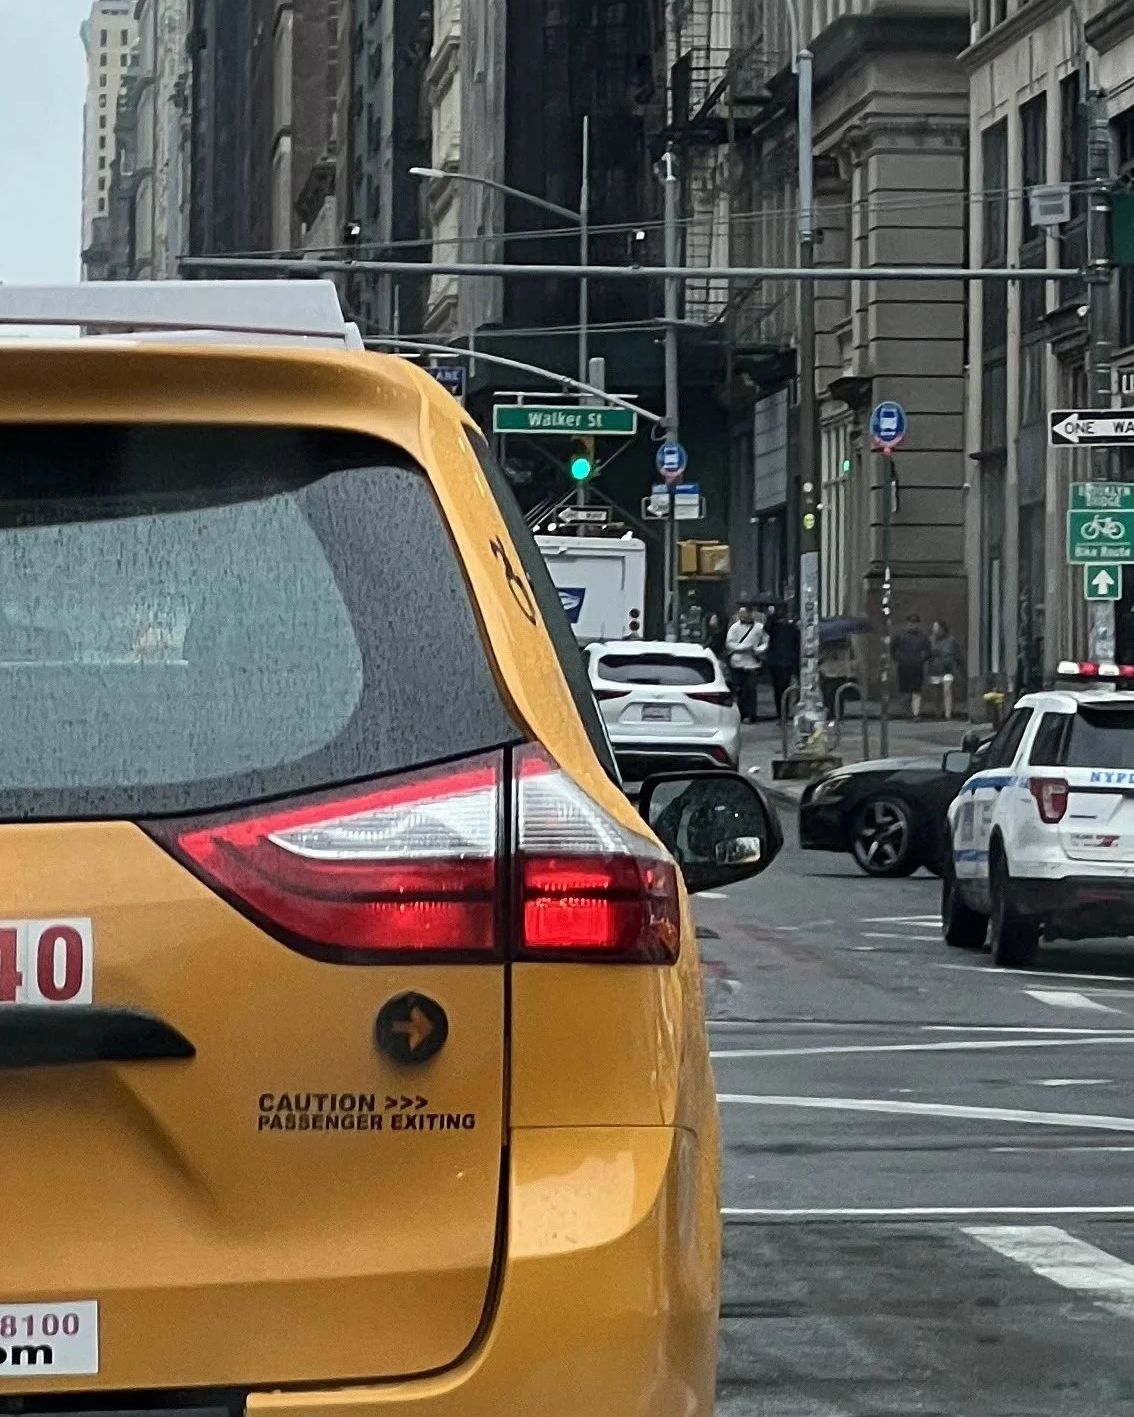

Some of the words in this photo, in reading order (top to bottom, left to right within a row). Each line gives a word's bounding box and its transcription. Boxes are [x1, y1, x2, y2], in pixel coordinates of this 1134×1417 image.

[528, 411, 581, 428] Walker
[587, 411, 602, 428] St
[1064, 422, 1096, 435] ONE
[258, 1093, 375, 1113] CAUTION
[257, 1113, 383, 1131] PASSENGER
[391, 1114, 476, 1130] EXITING
[0, 1313, 79, 1337] 8100
